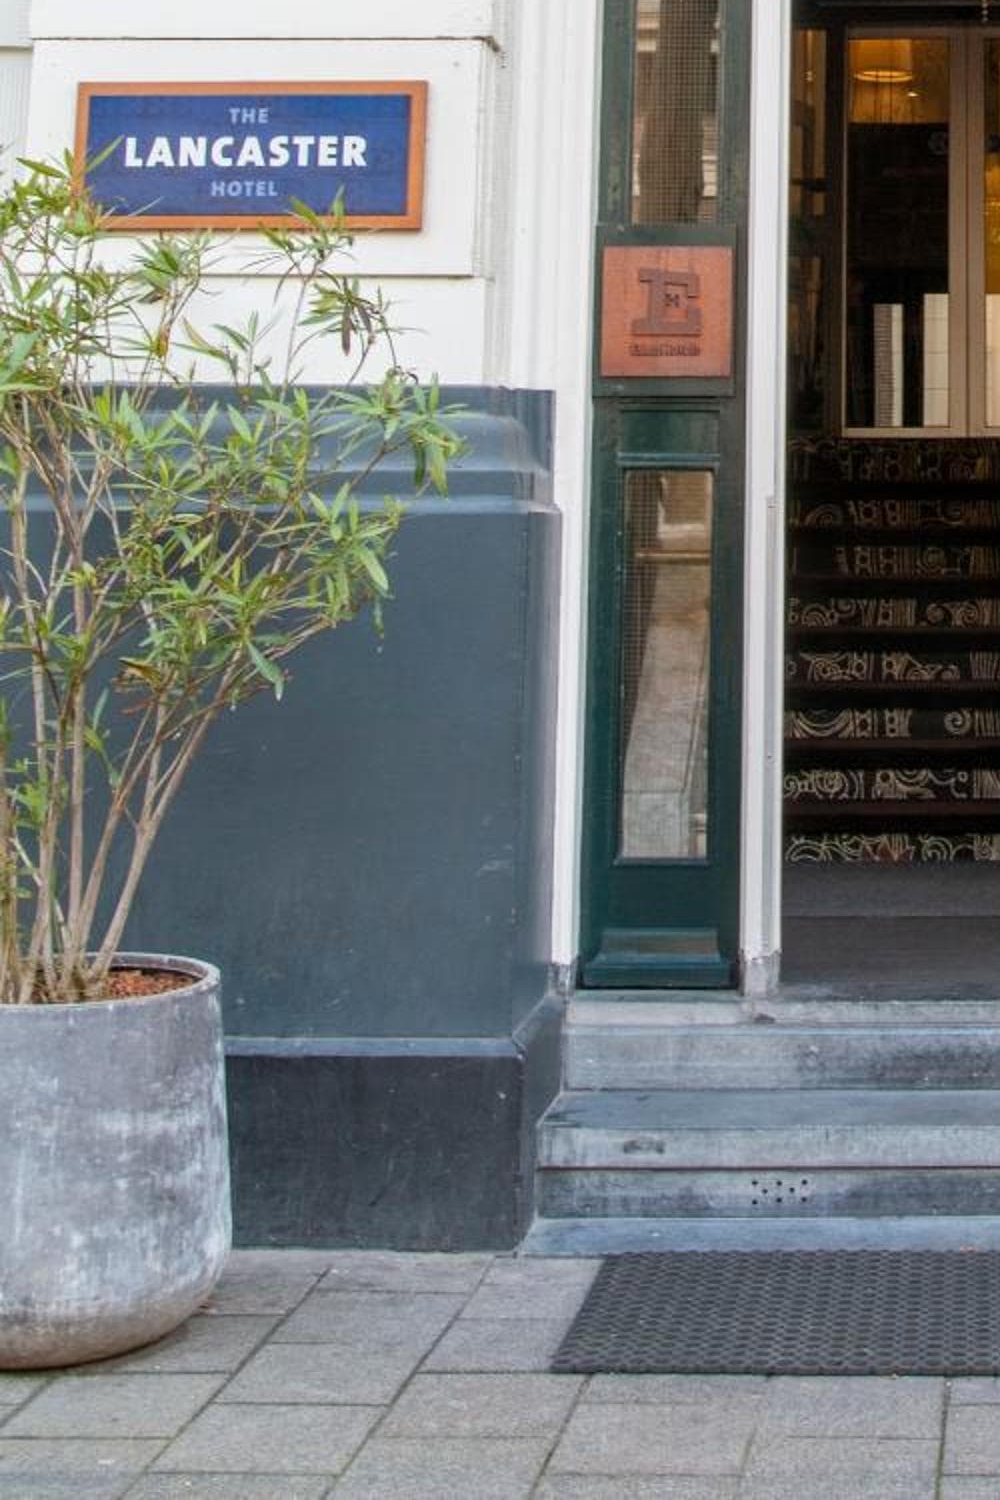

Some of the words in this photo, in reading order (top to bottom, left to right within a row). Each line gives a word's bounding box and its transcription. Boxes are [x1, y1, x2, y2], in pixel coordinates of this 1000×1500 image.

[229, 108, 269, 124] THE
[124, 135, 368, 167] LANCASTER
[211, 181, 278, 197] HOTEL
